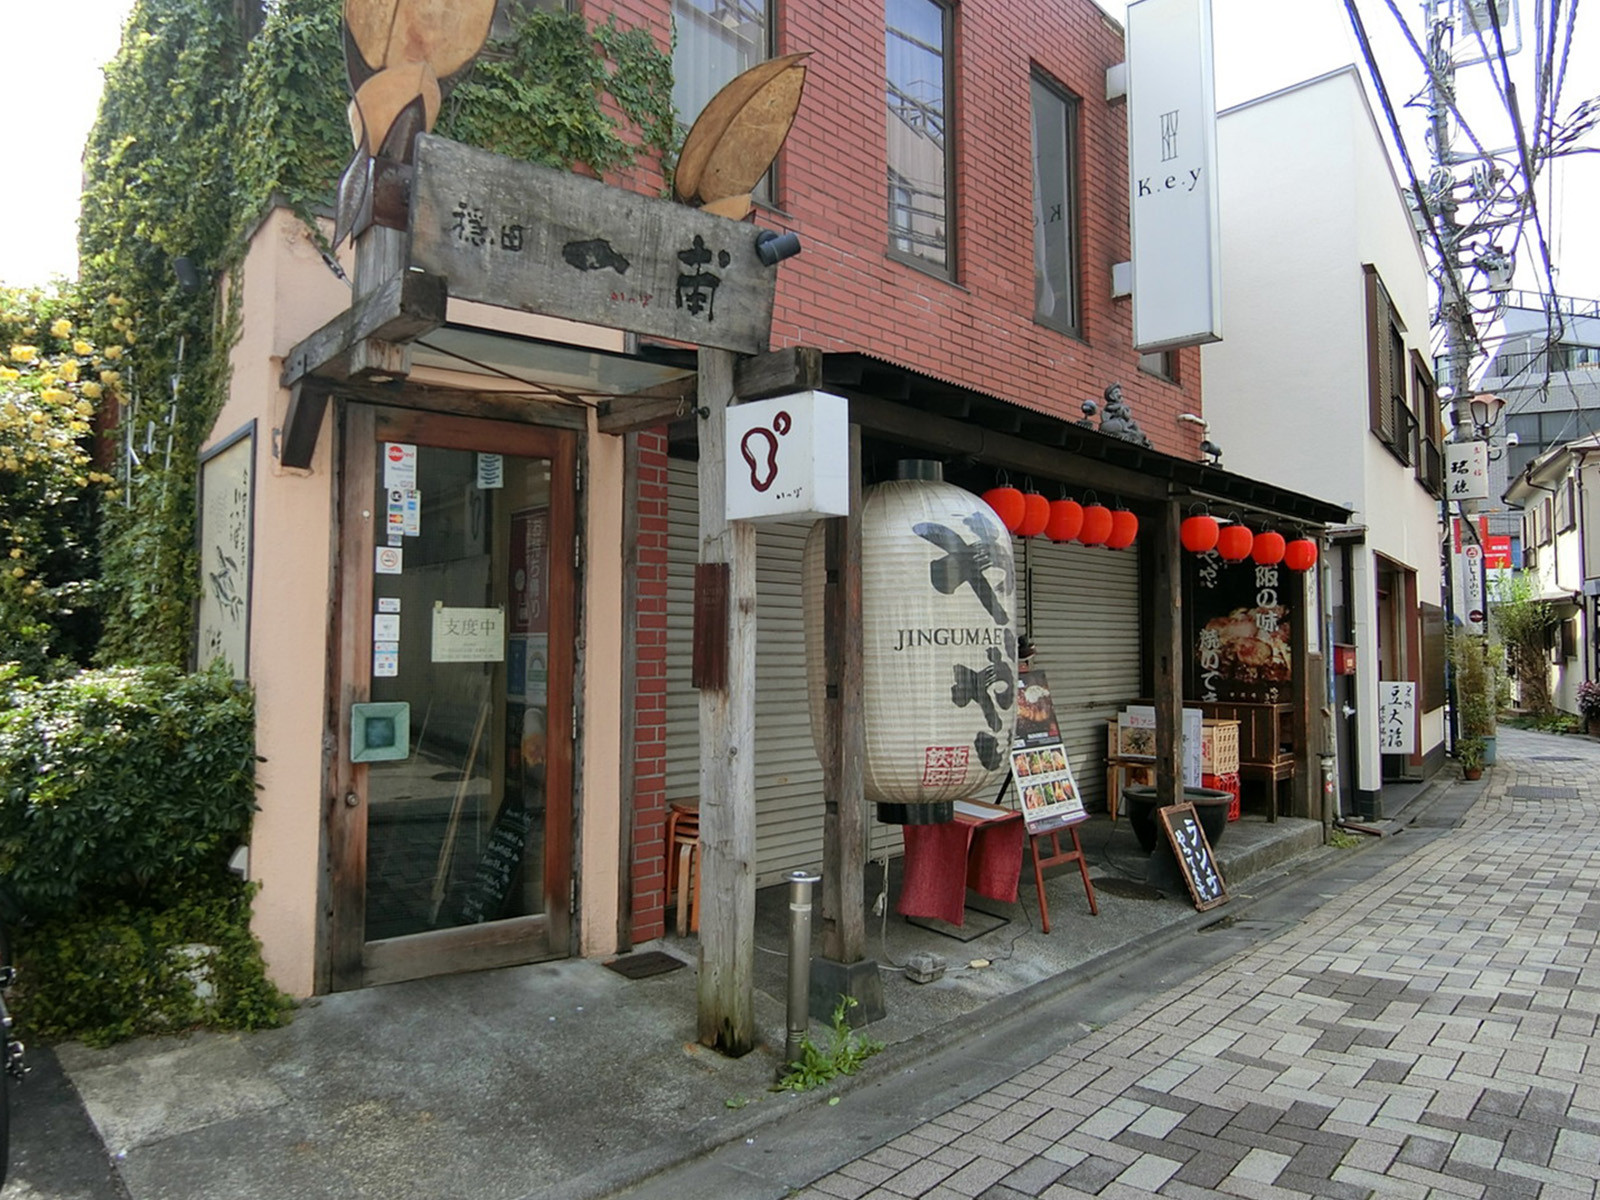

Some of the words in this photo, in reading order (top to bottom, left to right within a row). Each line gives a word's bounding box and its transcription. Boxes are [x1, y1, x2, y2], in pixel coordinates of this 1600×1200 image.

[1254, 562, 1279, 632] 阪の味
[443, 617, 496, 637] 支度中
[893, 626, 1003, 652] JINGUMAE
[1183, 818, 1218, 896] ランチ
